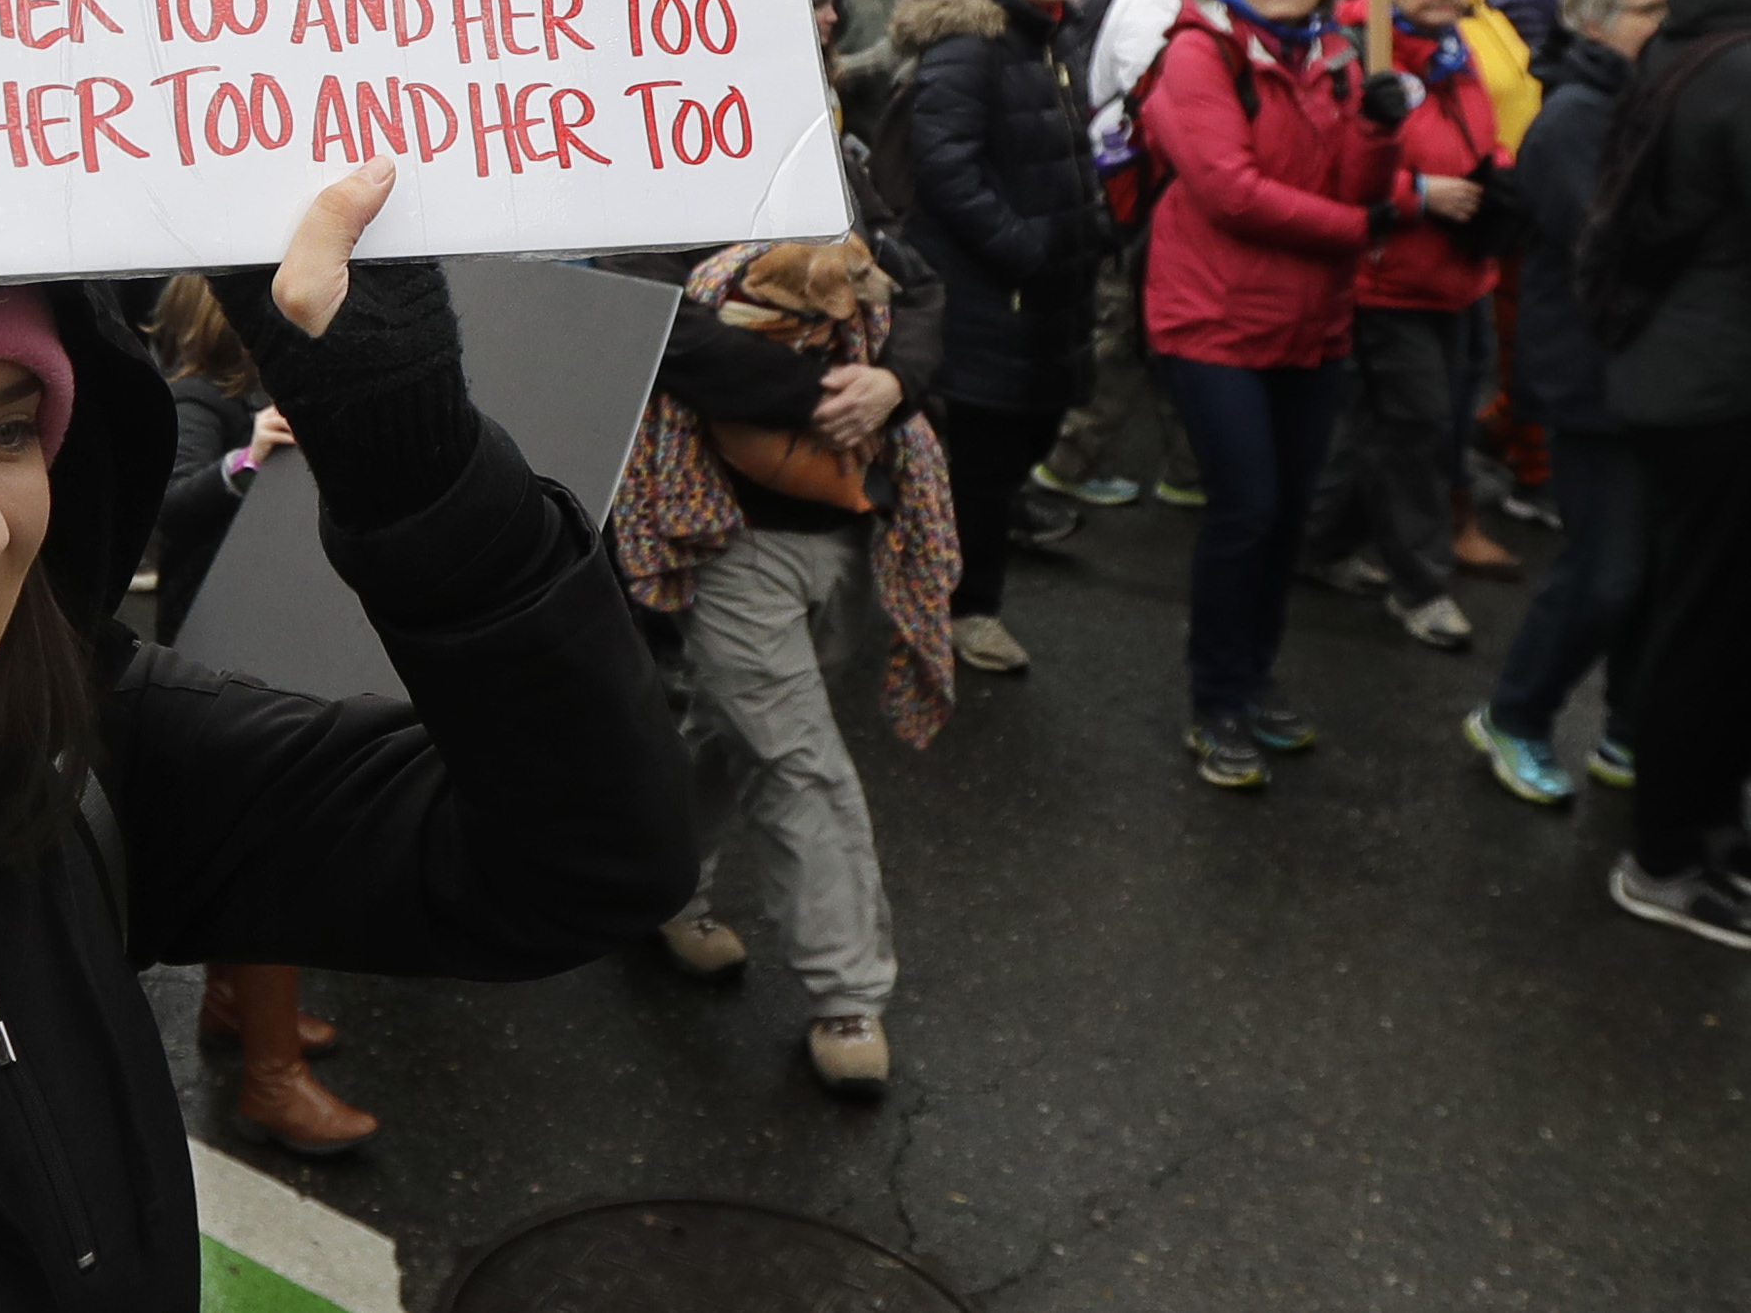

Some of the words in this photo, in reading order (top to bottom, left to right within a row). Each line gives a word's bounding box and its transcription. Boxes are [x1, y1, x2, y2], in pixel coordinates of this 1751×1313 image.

[151, 66, 293, 166] TOO
[312, 74, 457, 163] AND
[468, 82, 612, 177] HER
[624, 80, 752, 170] TOO
